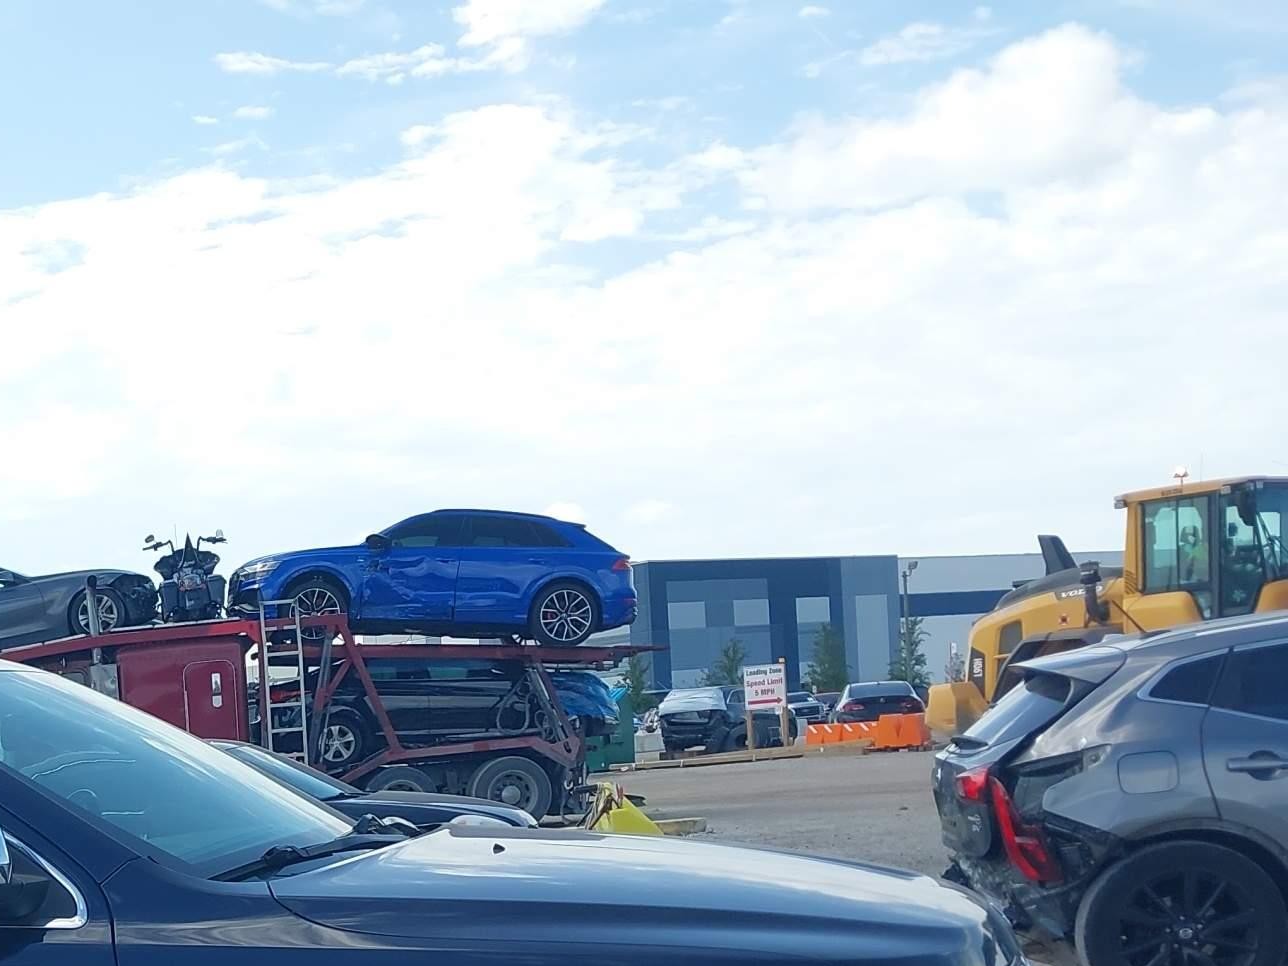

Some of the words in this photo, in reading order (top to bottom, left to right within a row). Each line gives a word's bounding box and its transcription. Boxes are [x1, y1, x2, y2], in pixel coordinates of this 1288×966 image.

[1061, 585, 1103, 597] VOLO
[746, 679, 766, 688] Speed
[767, 677, 783, 685] Limit
[761, 688, 775, 696] MPH
